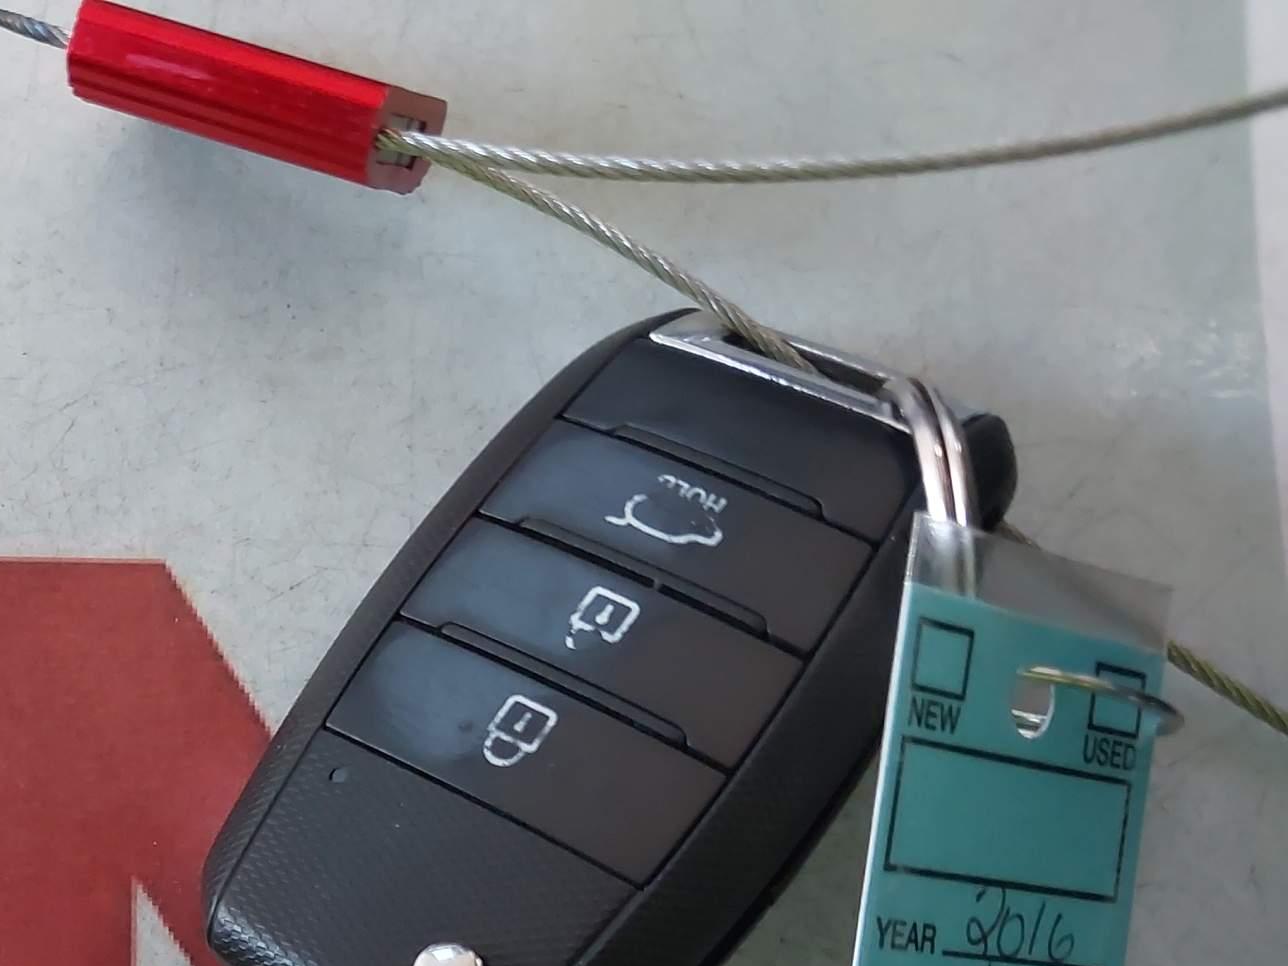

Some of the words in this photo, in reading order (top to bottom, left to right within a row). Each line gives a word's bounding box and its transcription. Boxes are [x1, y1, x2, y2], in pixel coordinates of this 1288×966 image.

[908, 698, 960, 735] NEW
[1083, 735, 1137, 772] USED
[876, 917, 937, 954] YEAR
[966, 886, 1075, 963] 2016
